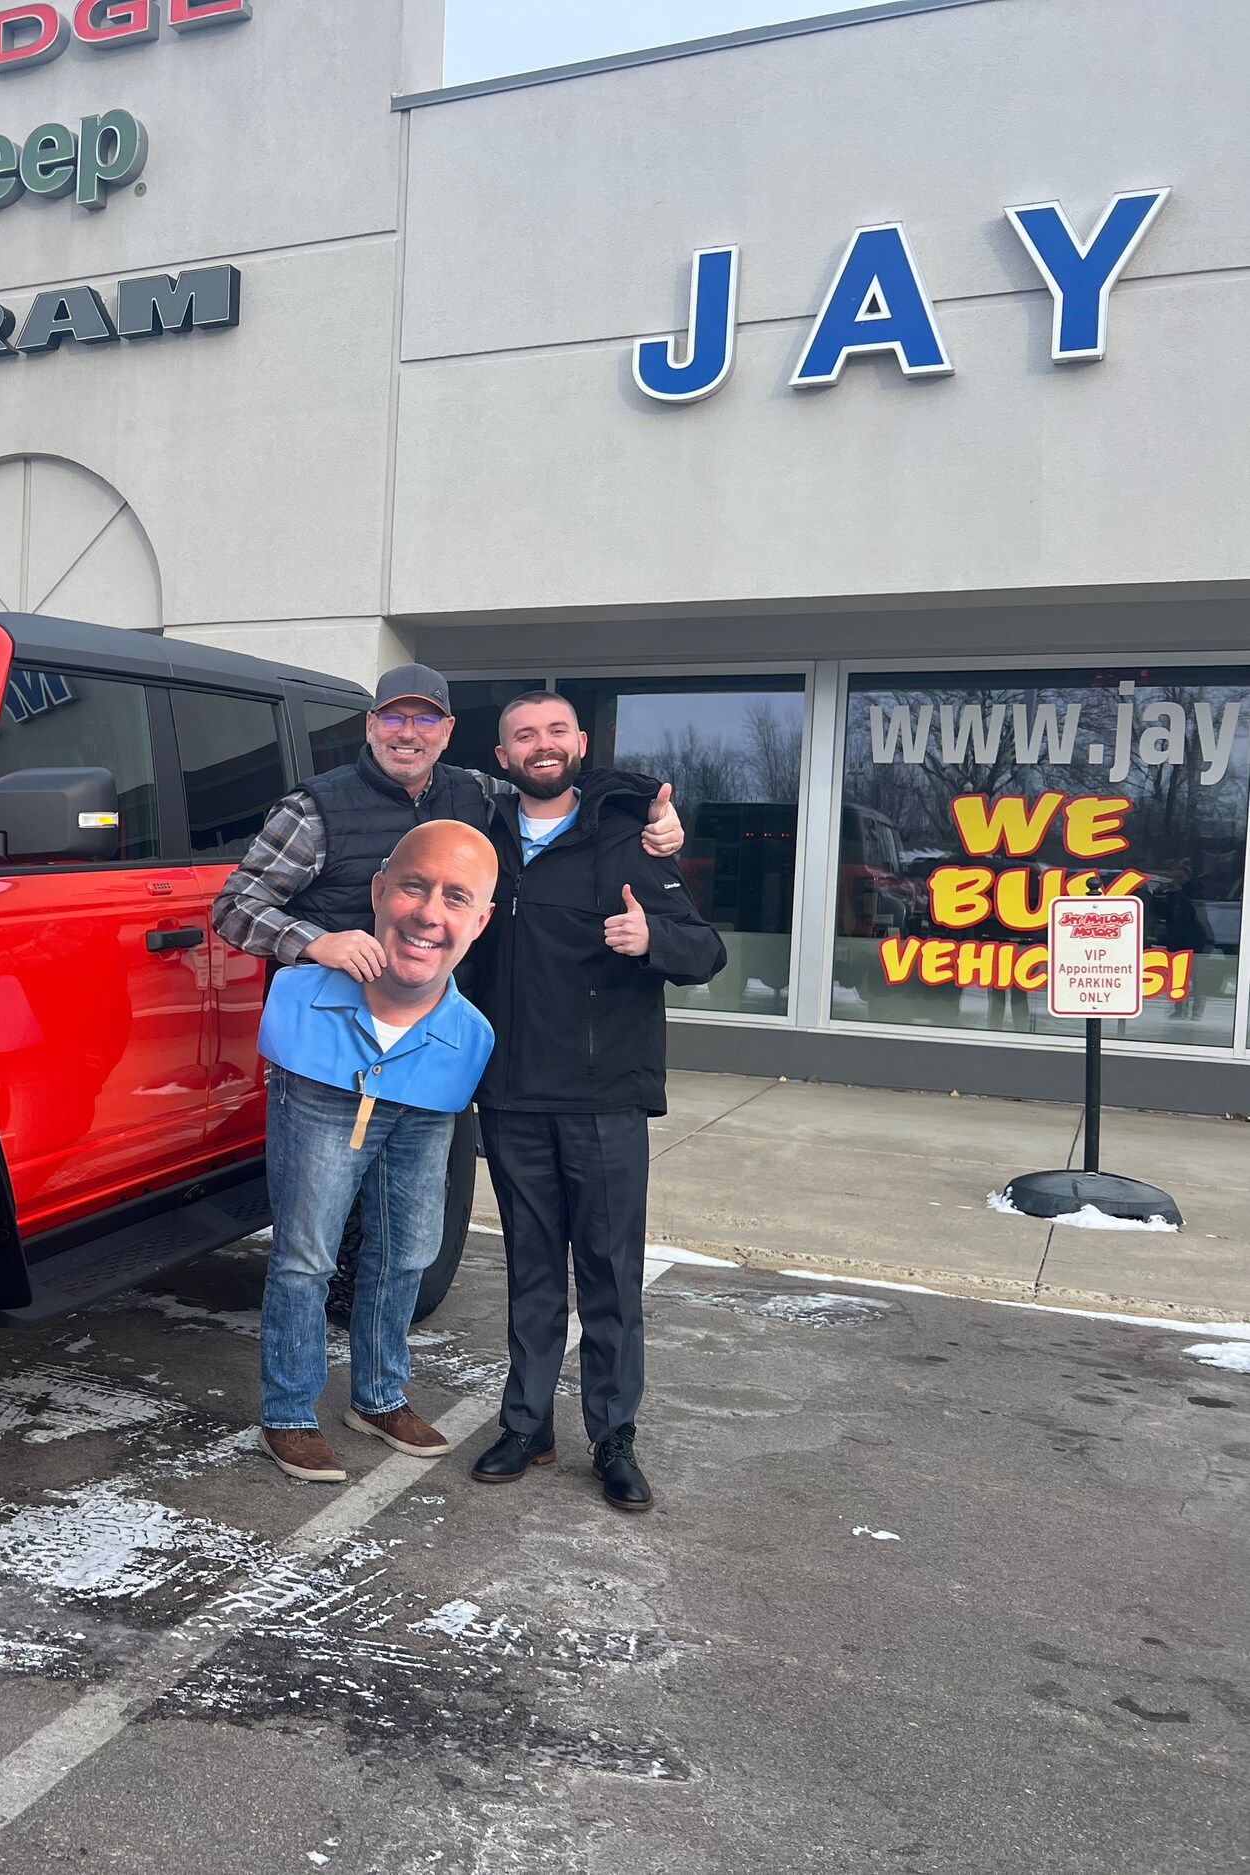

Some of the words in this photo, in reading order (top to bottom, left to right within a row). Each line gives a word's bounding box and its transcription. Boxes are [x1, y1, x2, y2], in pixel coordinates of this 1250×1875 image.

[632, 186, 1172, 401] JAY
[869, 680, 1242, 786] www.jay
[952, 792, 1131, 859] WE
[1082, 911, 1133, 926] MALONE
[1070, 926, 1121, 939] MOTORS
[1085, 949, 1107, 961] VIP
[880, 935, 1193, 1001] VEHICS!
[1059, 963, 1132, 976] Appointment
[1069, 977, 1122, 989] PARKING
[1079, 992, 1111, 1003] ONLY
